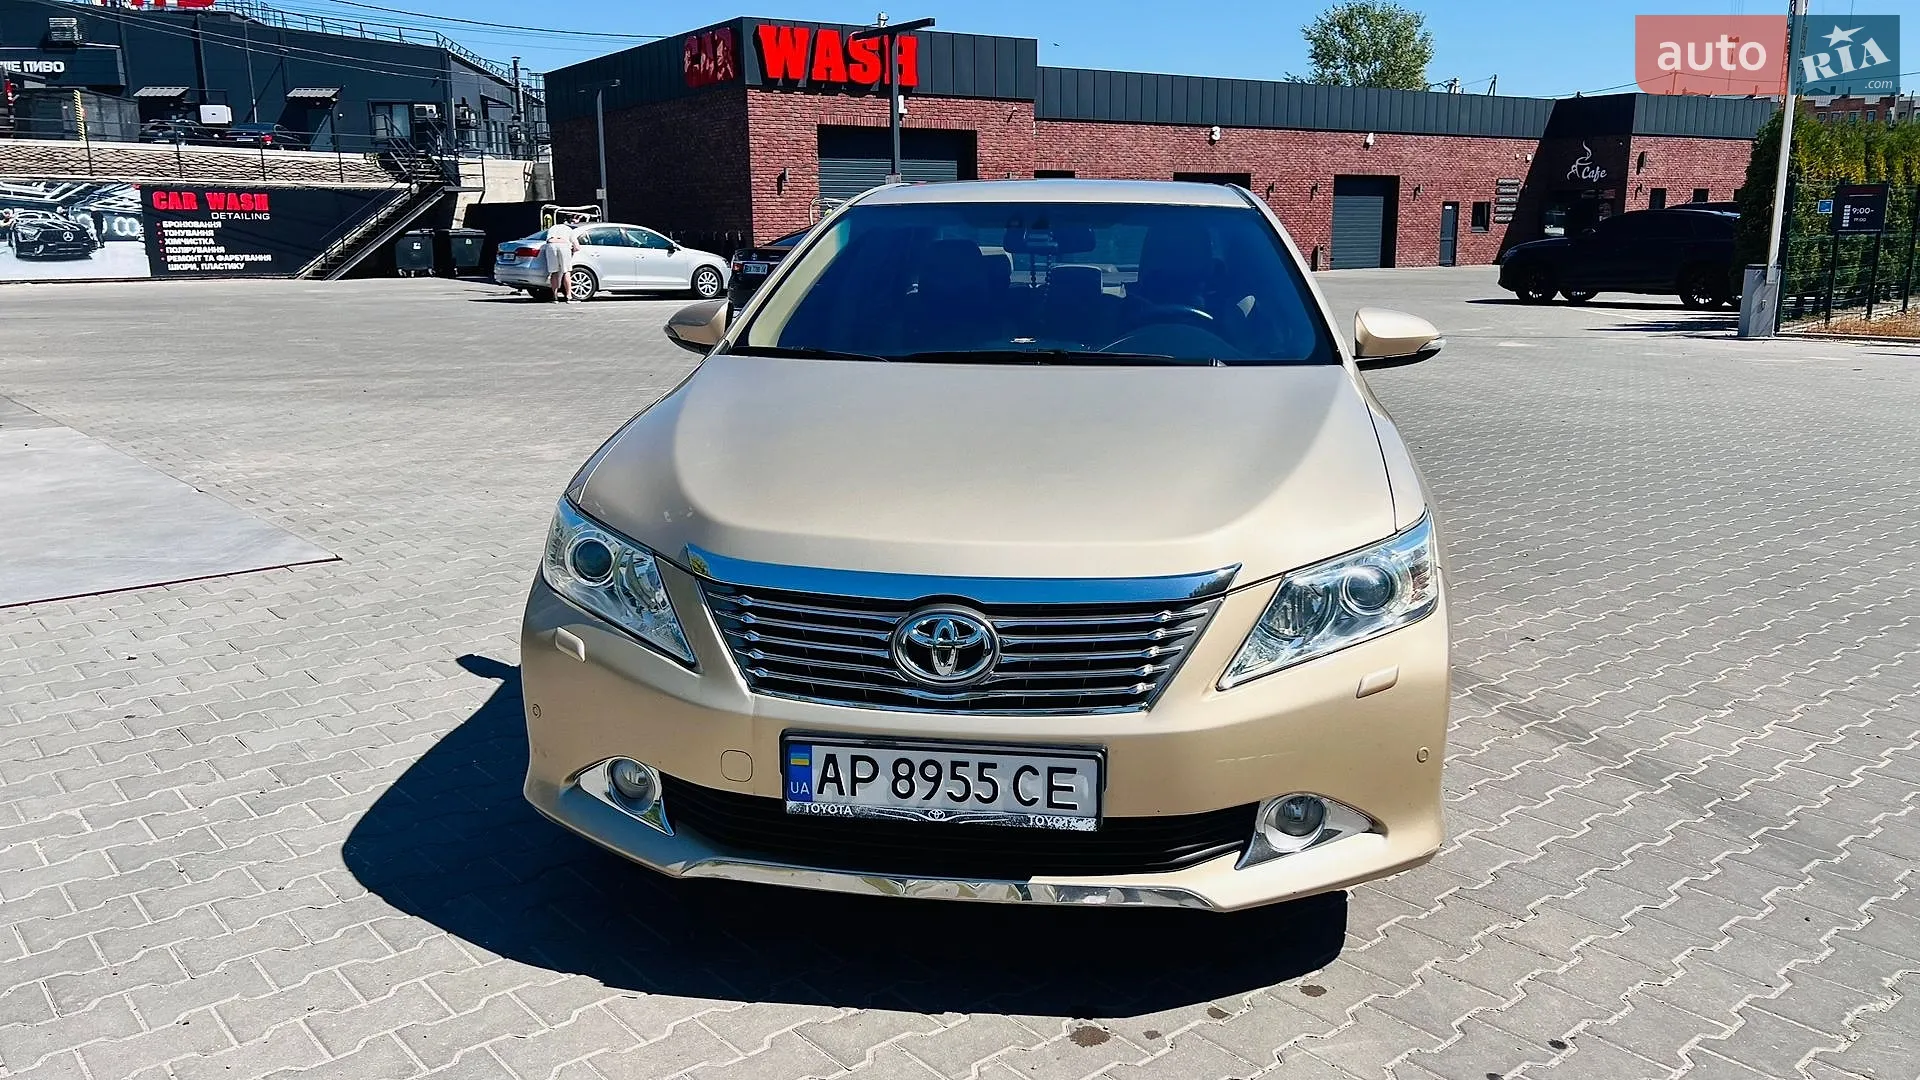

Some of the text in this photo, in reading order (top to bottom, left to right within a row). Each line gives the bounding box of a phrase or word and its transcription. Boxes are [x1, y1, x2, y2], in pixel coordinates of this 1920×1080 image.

[758, 24, 919, 86] WASH
[23, 61, 65, 73] ПИВО
[1211, 126, 1221, 140] 3
[1366, 132, 1374, 145] 4
[1581, 166, 1607, 182] Cafe
[152, 191, 269, 210] CAR WASH
[211, 212, 271, 220] DETAILING
[163, 229, 215, 237] ТОНУВАННЯ
[790, 780, 810, 795] UA
[817, 753, 1079, 811] AP 8955 CE
[804, 803, 853, 816] TOYOTA
